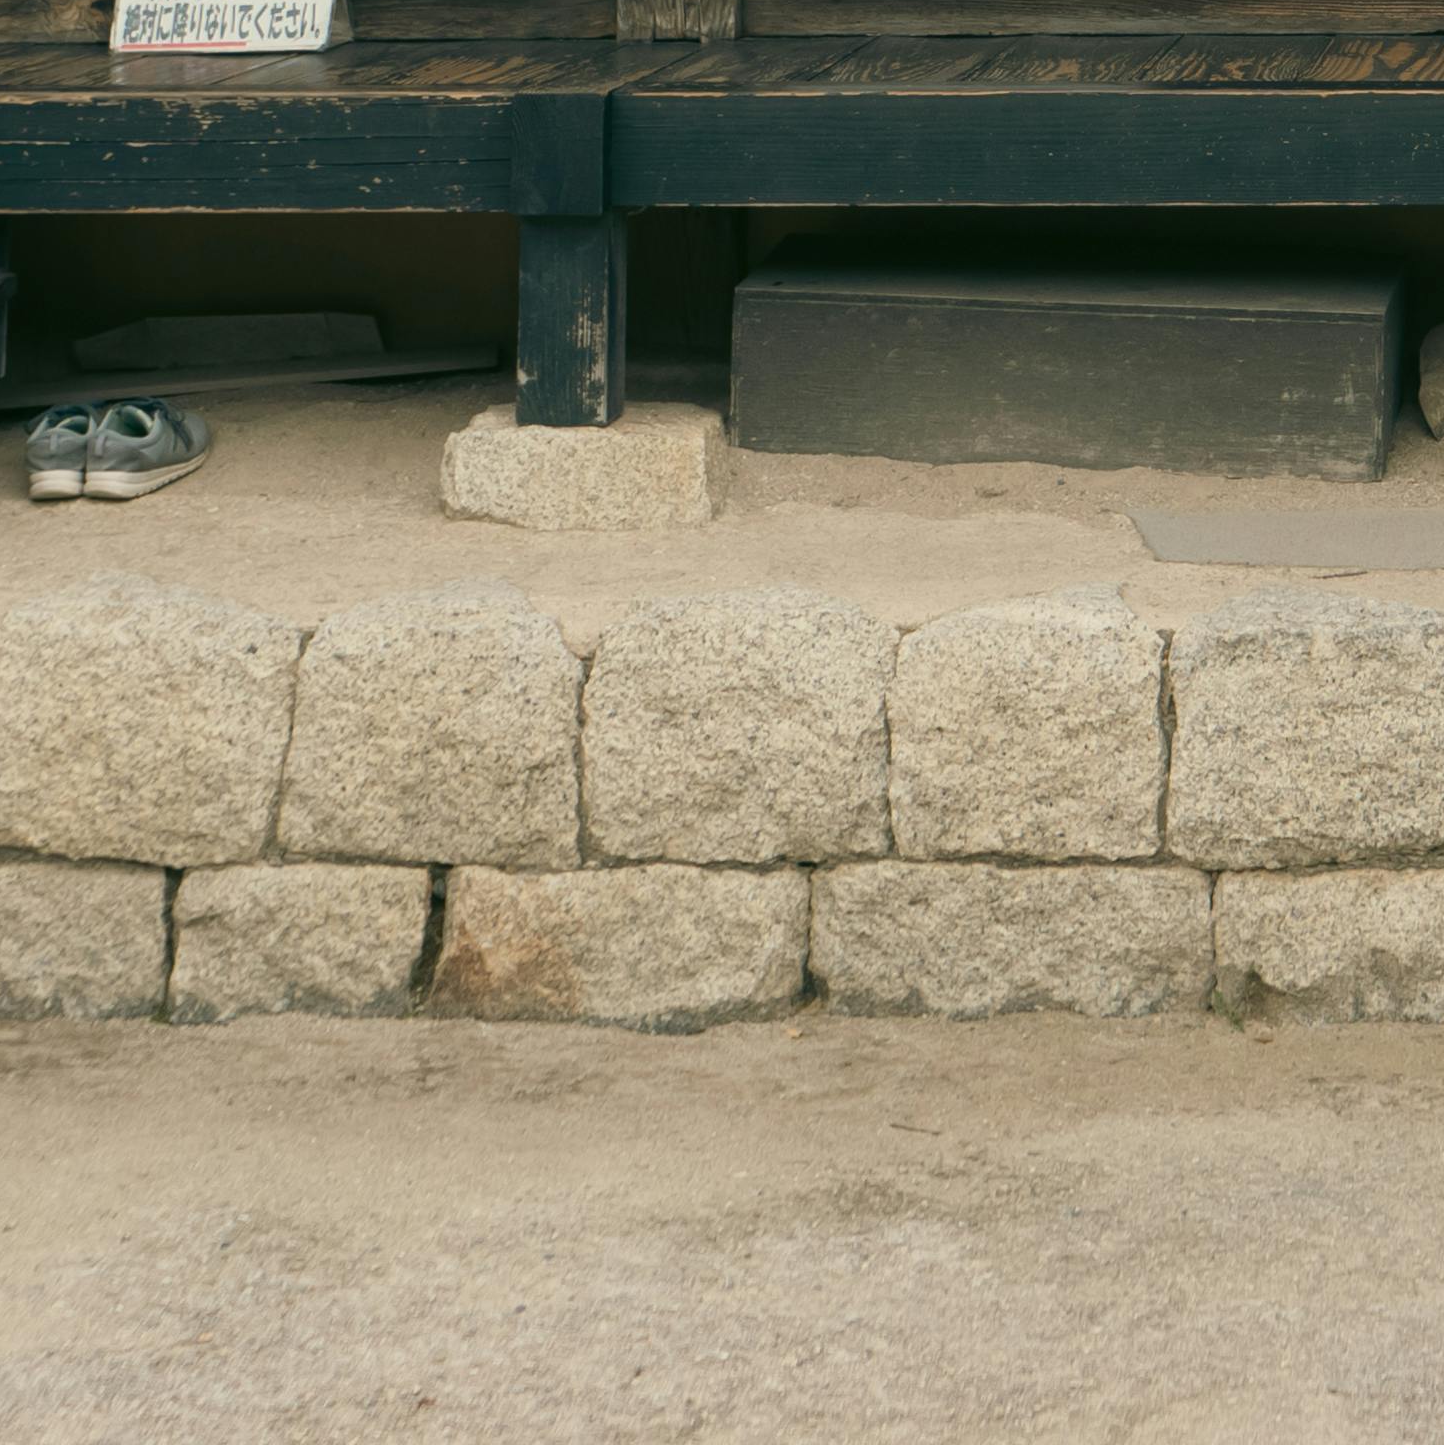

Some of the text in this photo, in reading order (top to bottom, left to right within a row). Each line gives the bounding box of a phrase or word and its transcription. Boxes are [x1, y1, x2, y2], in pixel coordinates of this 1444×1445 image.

[123, 3, 321, 43] 絶対に降りないでください。
